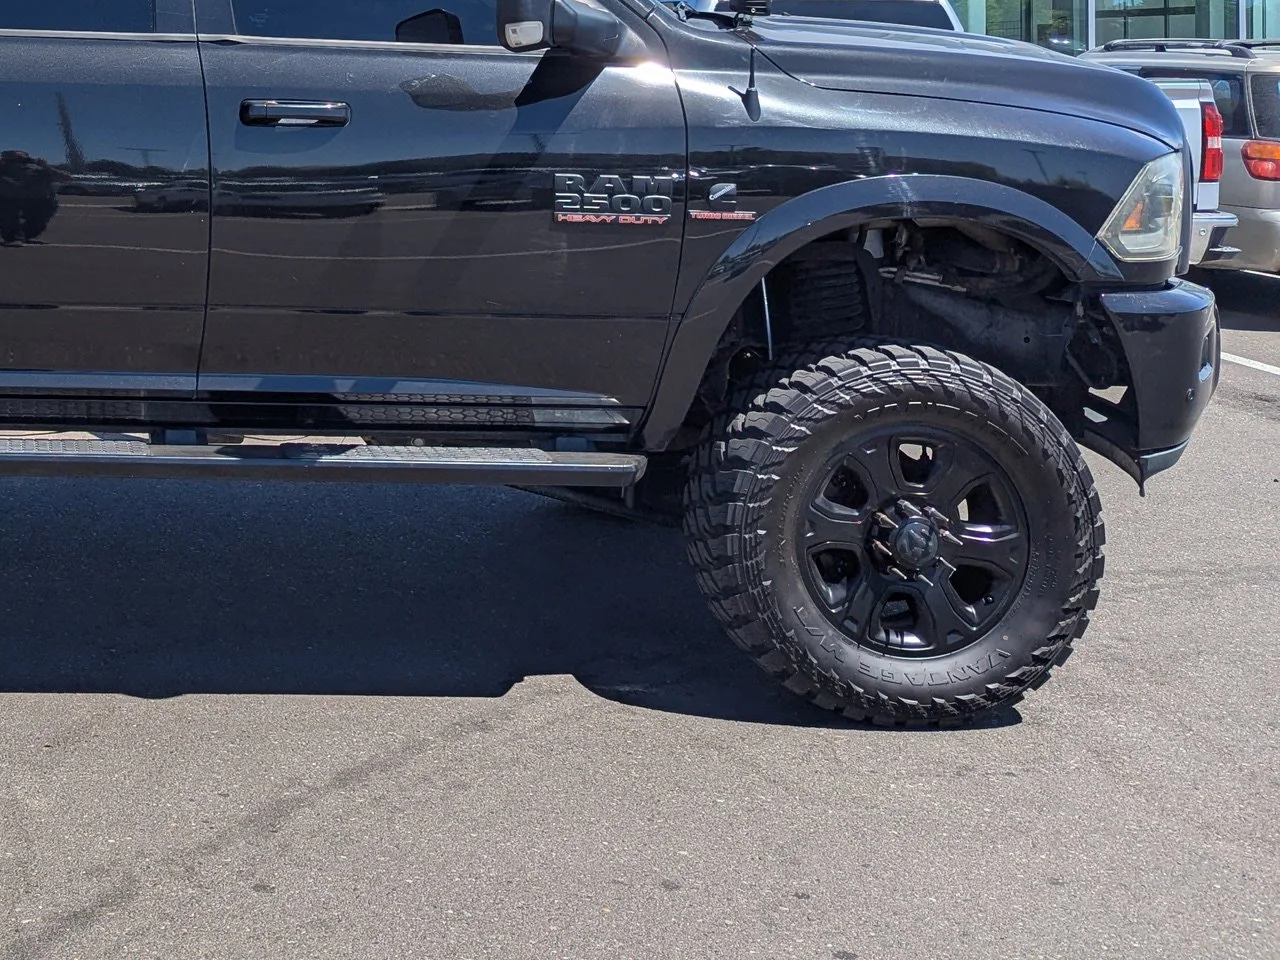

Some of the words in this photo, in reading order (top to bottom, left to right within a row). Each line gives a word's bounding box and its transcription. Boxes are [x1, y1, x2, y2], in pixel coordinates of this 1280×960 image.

[554, 173, 672, 193] RAM
[554, 193, 672, 213] 2500
[558, 214, 617, 223] HEAVY
[618, 215, 669, 224] DUTY
